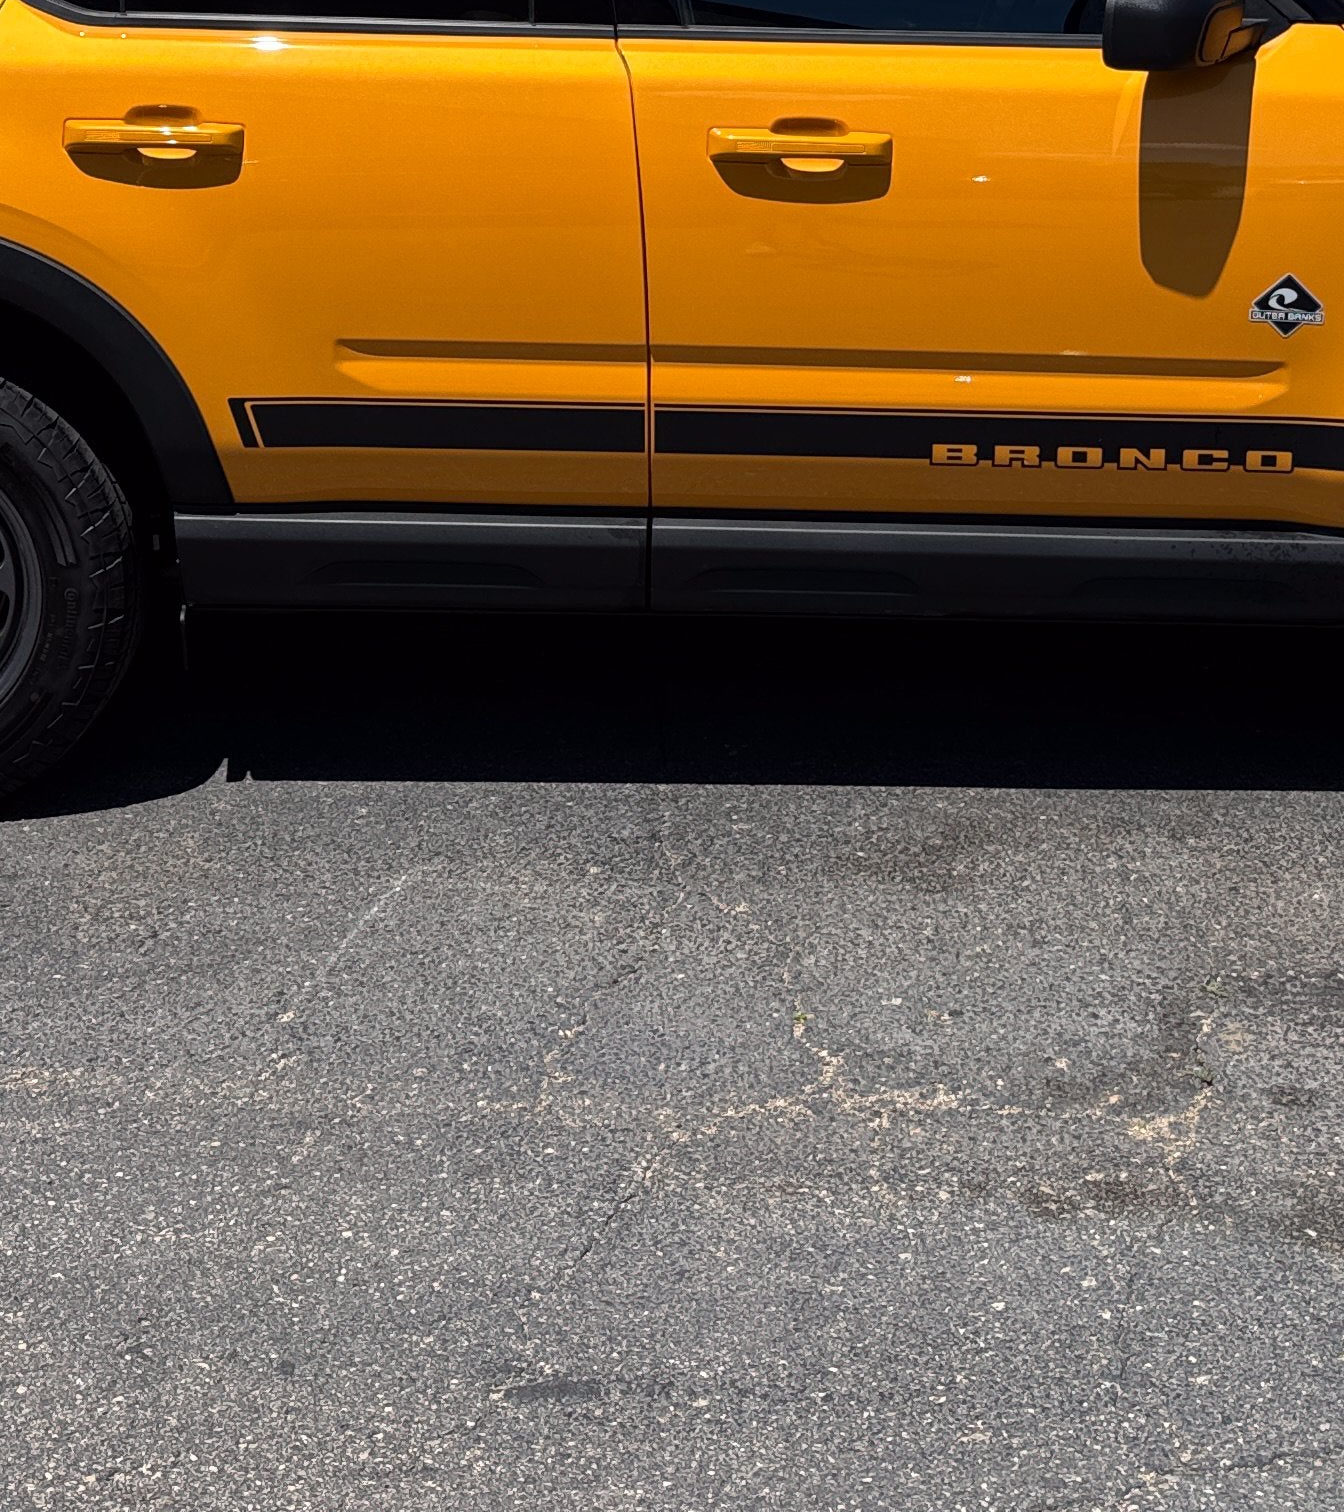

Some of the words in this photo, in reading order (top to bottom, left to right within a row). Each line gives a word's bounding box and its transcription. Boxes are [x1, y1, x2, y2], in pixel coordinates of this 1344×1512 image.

[1251, 311, 1285, 321] OUTER
[1287, 312, 1322, 322] BANKS
[929, 442, 1295, 474] BRONCO
